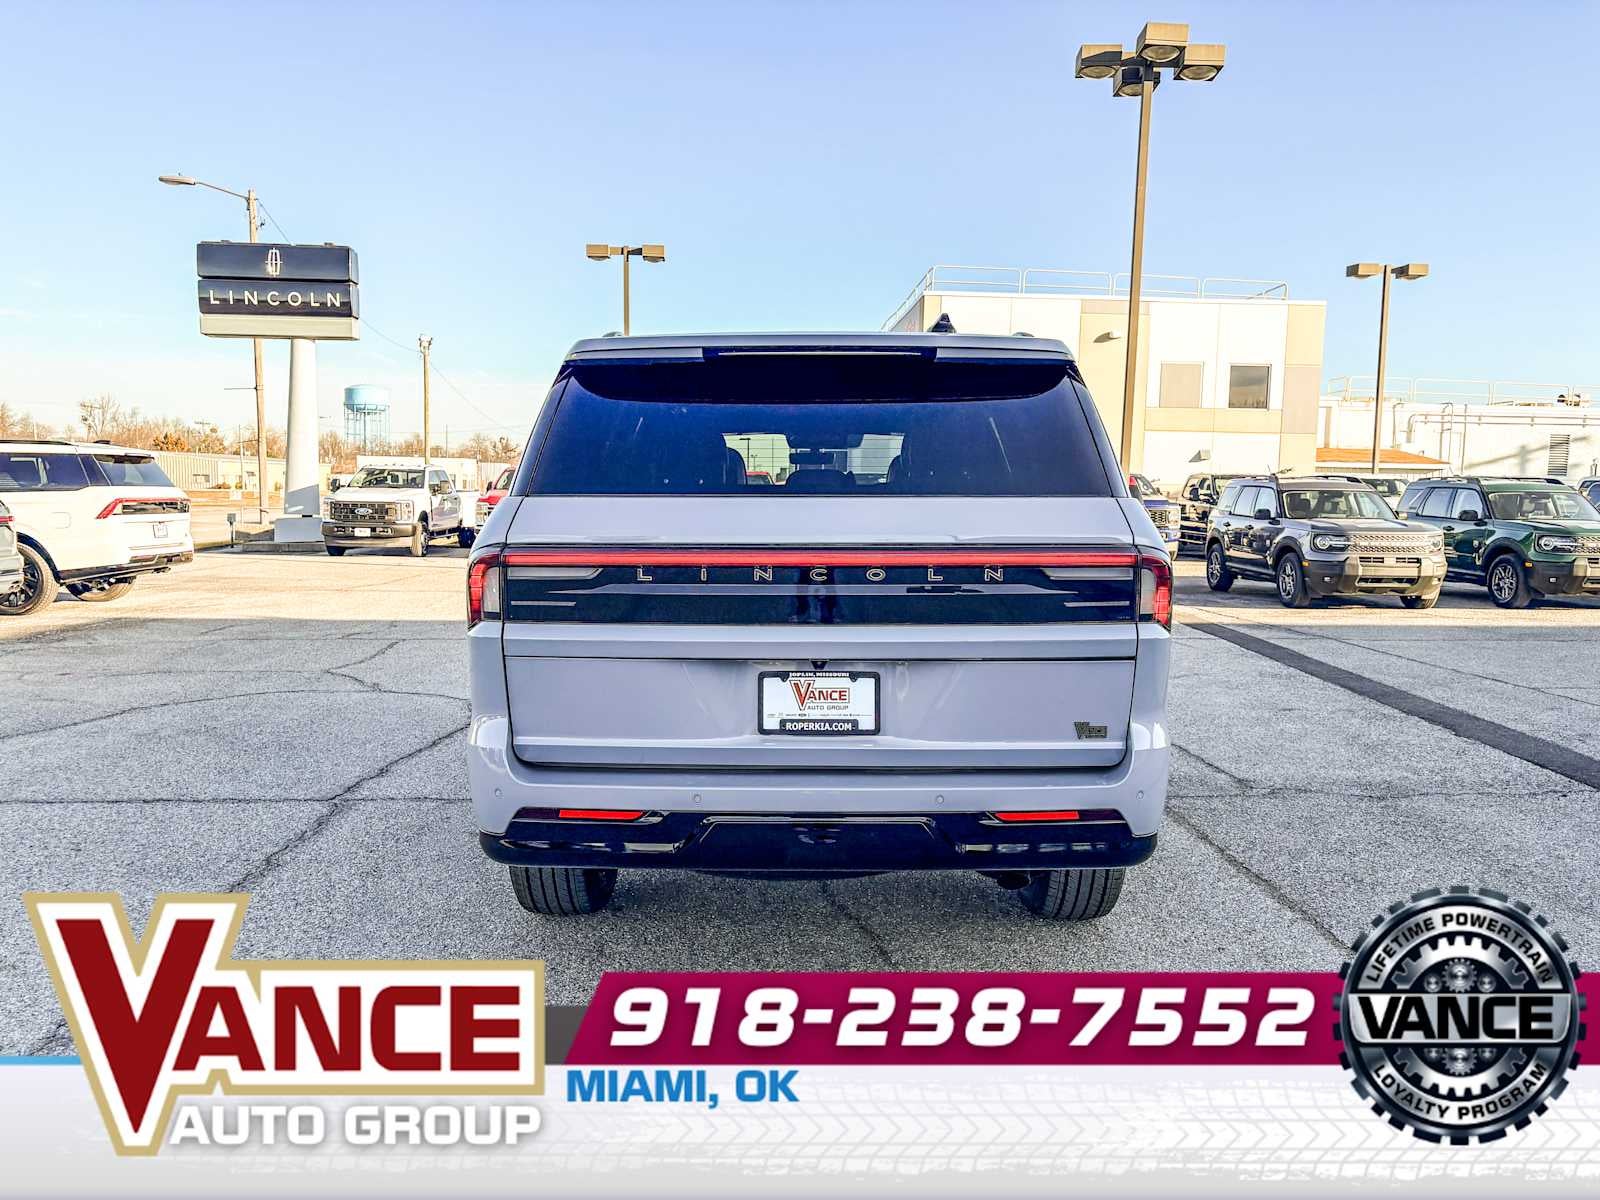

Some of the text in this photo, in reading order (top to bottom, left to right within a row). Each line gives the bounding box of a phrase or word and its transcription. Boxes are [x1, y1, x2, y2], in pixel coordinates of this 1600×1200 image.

[209, 290, 341, 307] LINCOLN
[636, 568, 1004, 582] LINCOLN
[791, 681, 848, 708] VANCE
[786, 722, 852, 731] ROPERKIA.COM
